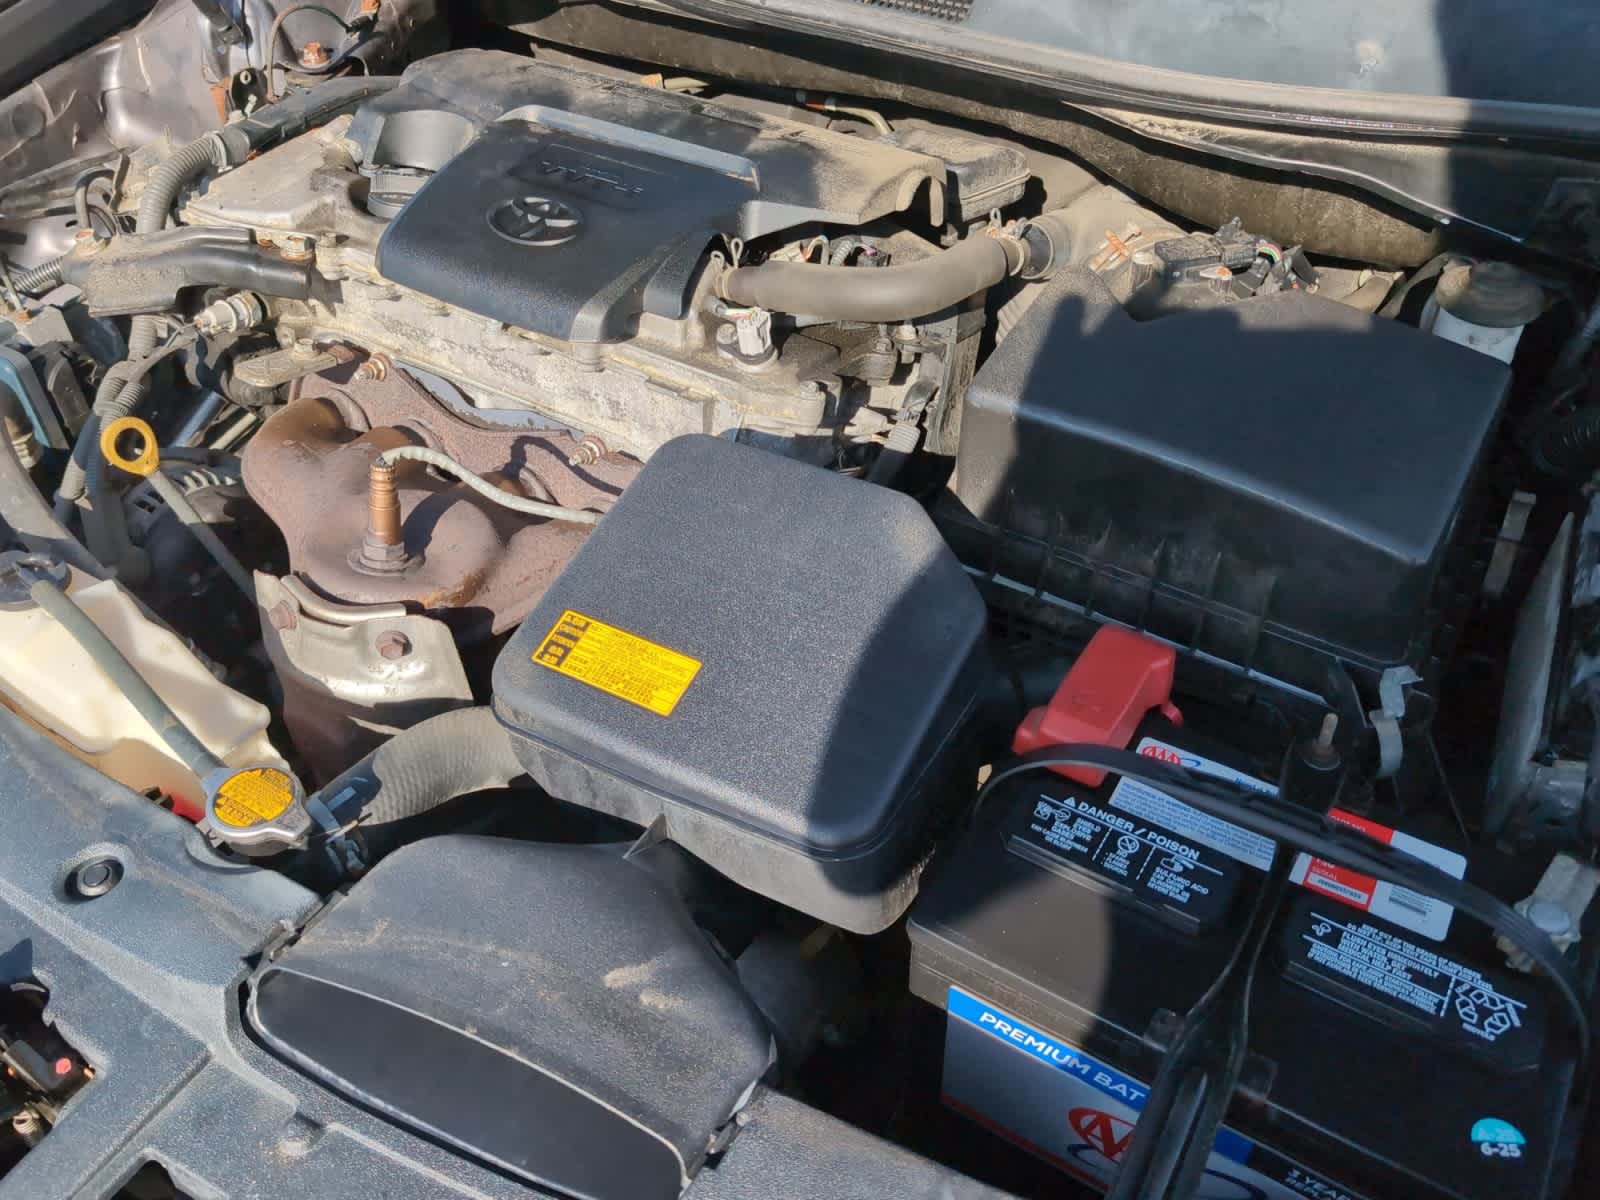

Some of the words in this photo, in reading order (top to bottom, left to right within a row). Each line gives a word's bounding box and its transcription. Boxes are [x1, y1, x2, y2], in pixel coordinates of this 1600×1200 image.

[1077, 800, 1135, 832] DANGER
[1145, 829, 1200, 861] POISON
[1190, 882, 1210, 895] ACID
[977, 1009, 1092, 1077] PREMIUM
[1480, 1142, 1521, 1157] 6-25
